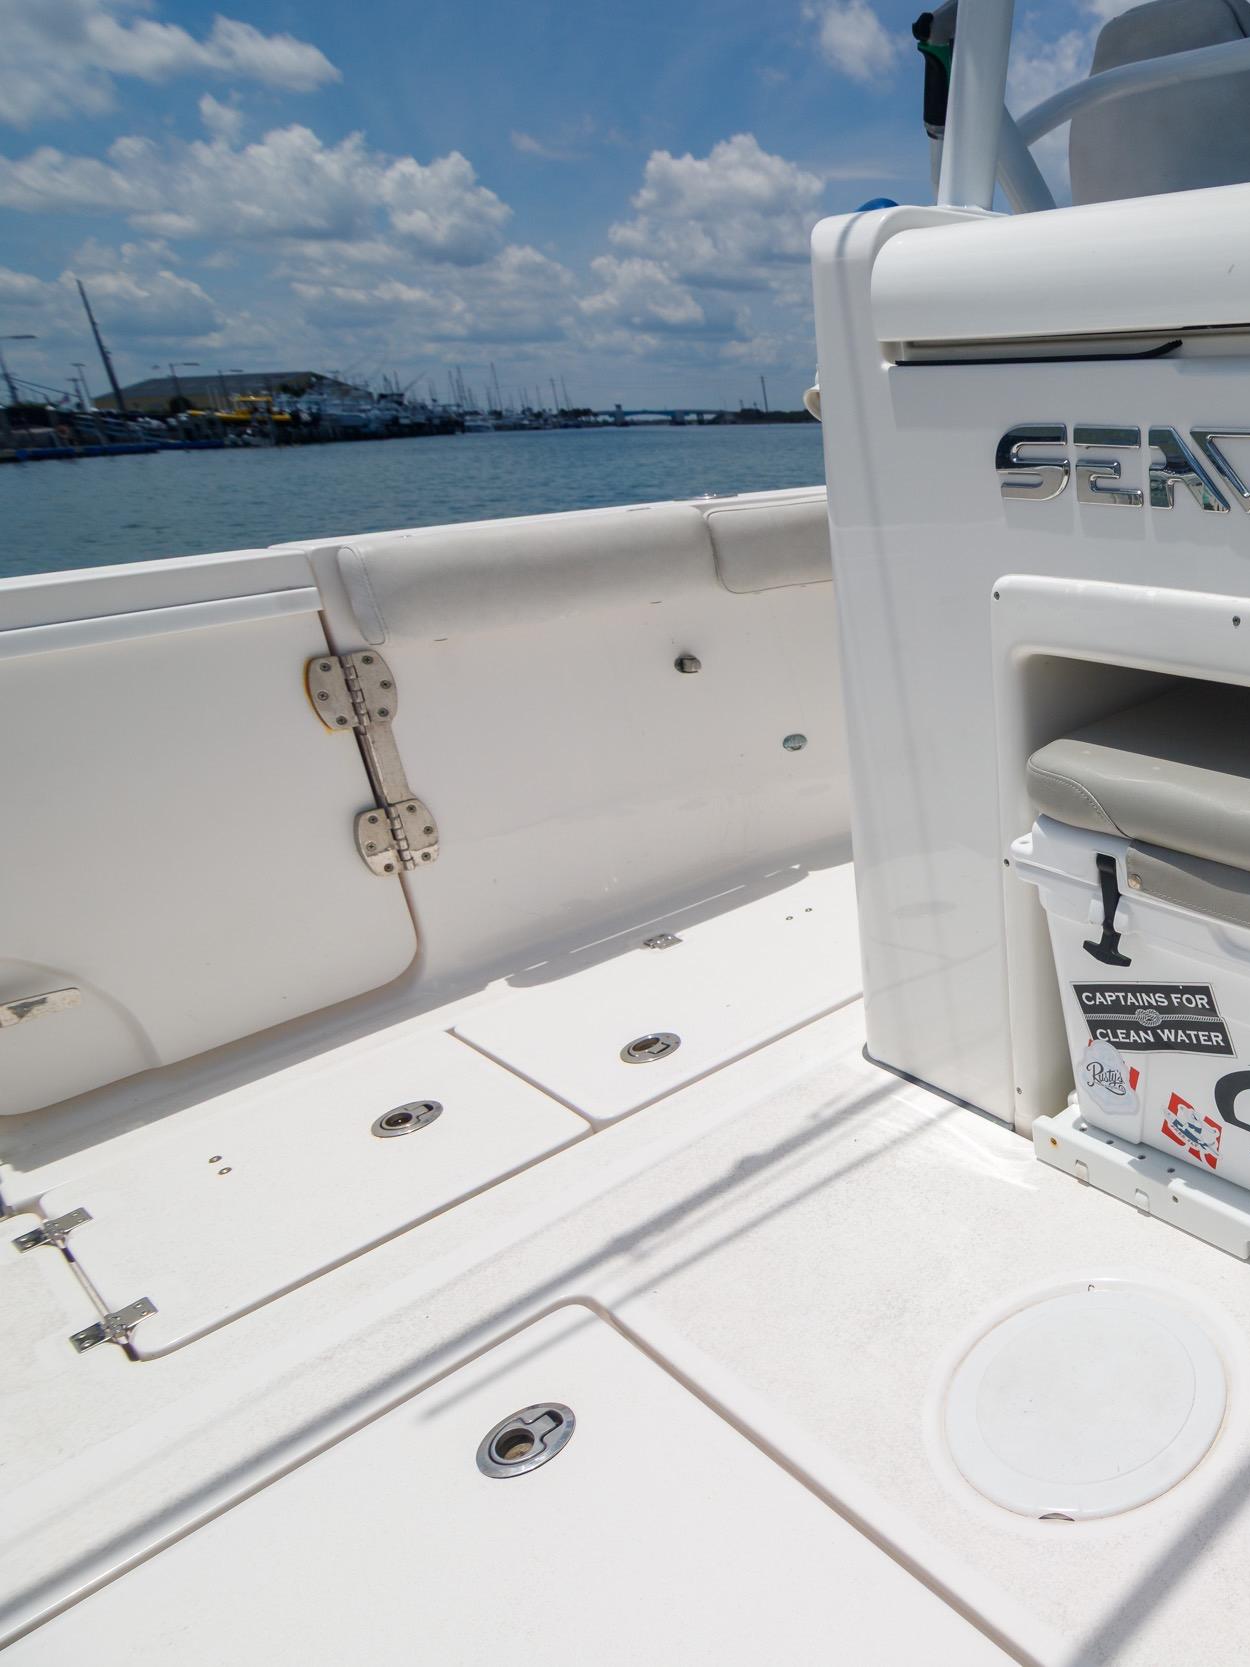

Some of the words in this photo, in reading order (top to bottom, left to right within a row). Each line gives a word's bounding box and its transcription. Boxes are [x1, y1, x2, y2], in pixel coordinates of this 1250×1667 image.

[1082, 992, 1169, 1006] CAPTAINS
[1171, 993, 1210, 1009] FOR
[1096, 1028, 1154, 1043] CLEAN
[1157, 1029, 1226, 1046] WATER
[1086, 1061, 1127, 1096] Rusty's
